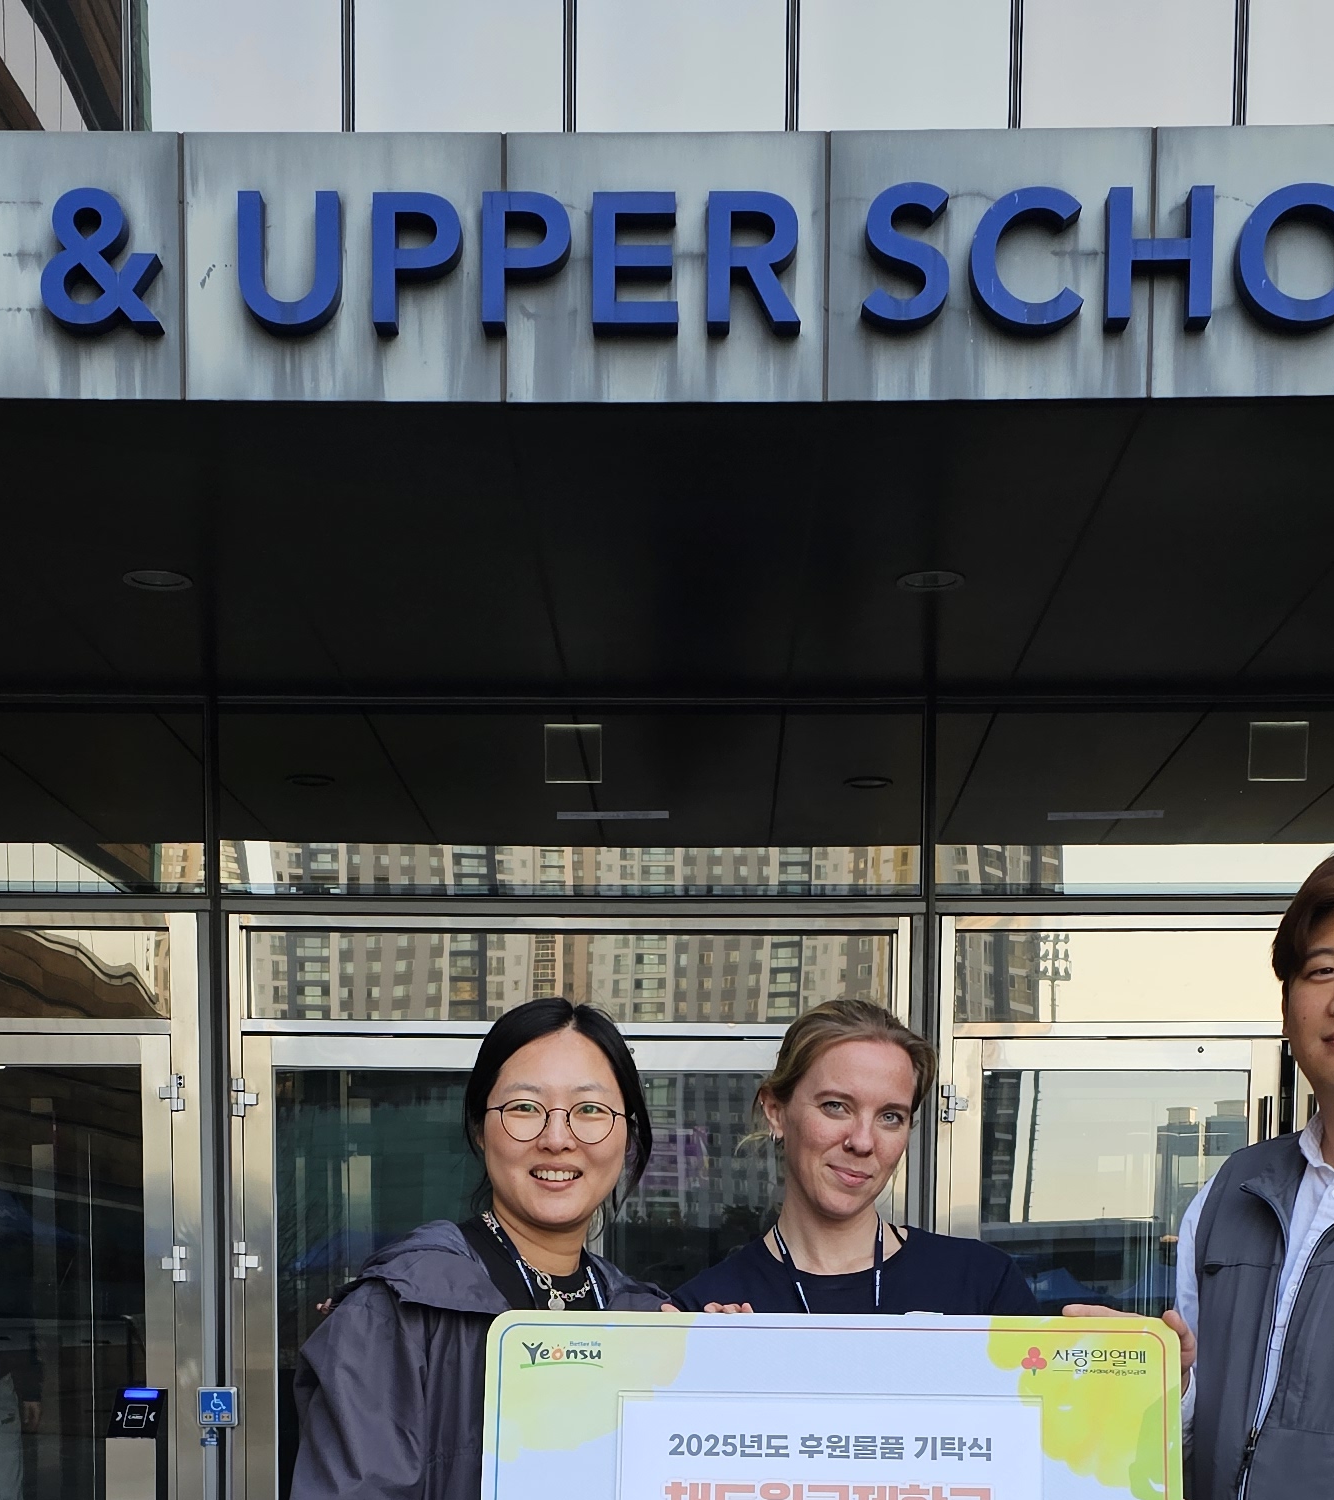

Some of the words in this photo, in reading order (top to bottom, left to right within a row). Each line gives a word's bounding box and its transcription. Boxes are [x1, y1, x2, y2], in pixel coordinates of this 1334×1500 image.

[40, 187, 165, 335] &
[236, 189, 801, 337] UPPER
[521, 1342, 601, 1365] Yeonsu
[1052, 1349, 1146, 1367] 사랑의열매
[668, 1433, 790, 1458] 2025년도
[798, 1434, 905, 1460] 후원물품
[914, 1436, 993, 1462] 기탁식
